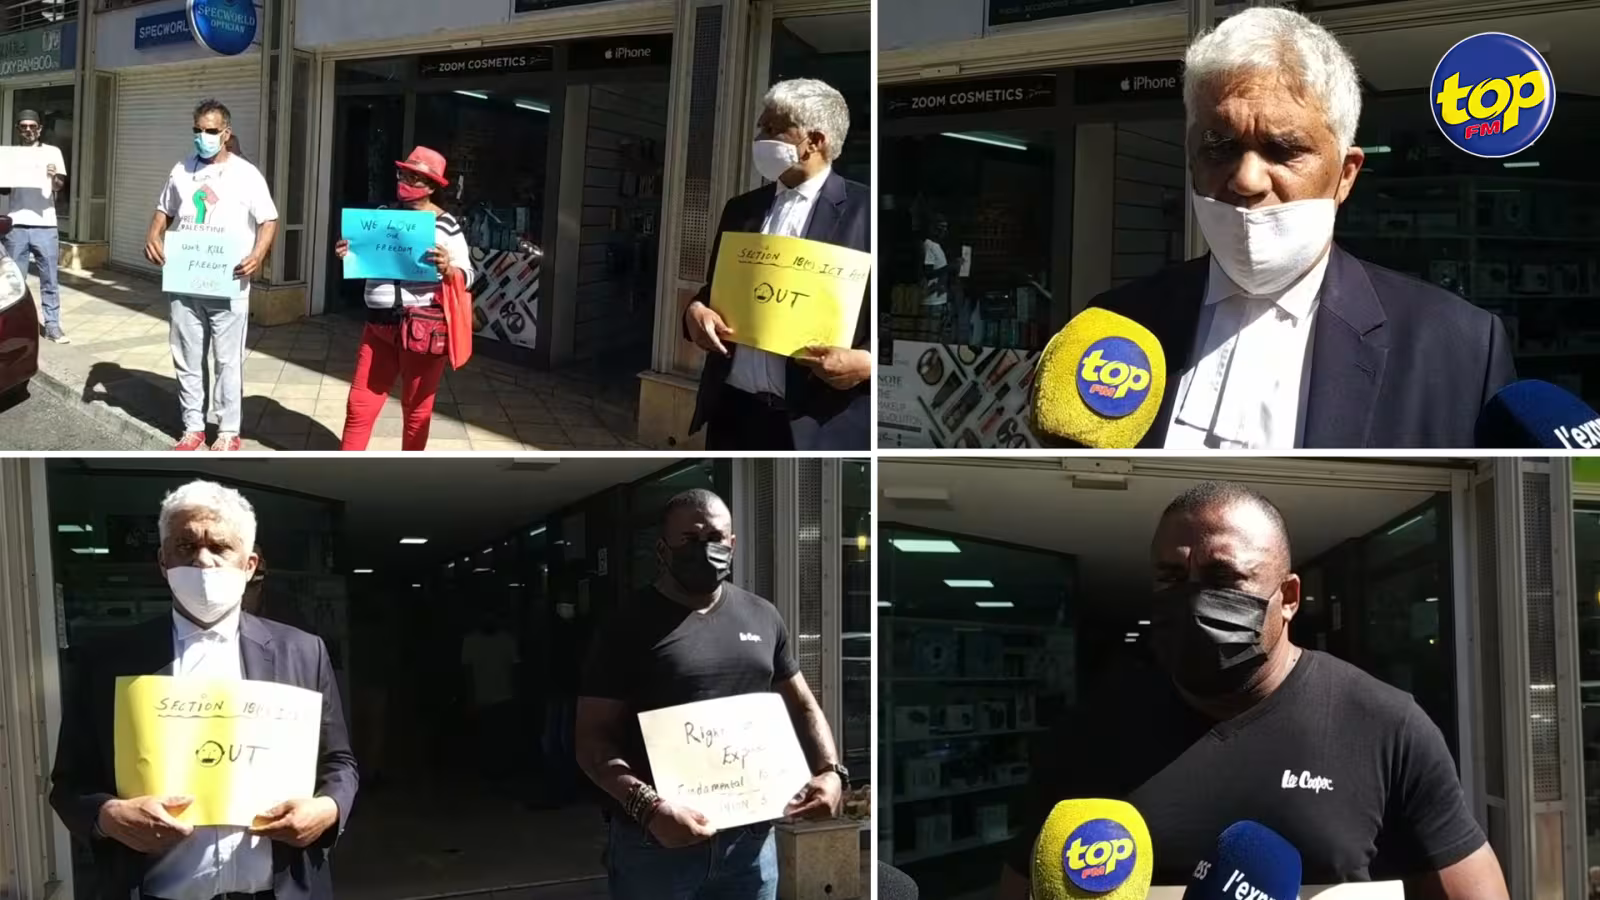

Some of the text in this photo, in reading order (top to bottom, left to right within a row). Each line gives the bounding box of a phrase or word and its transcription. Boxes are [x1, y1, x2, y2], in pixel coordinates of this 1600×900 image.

[197, 4, 256, 26] SPECWORLD
[139, 19, 193, 39] SPECWORL
[210, 19, 246, 33] OPTICIAN
[615, 47, 651, 59] iPhone
[17, 54, 52, 73] BAMBOO
[439, 56, 527, 72] ZOOM COSMETICS
[1133, 76, 1176, 90] iPhone
[911, 88, 1024, 109] ZOOM COSMETICS
[180, 223, 226, 233] PALESTINE
[360, 218, 417, 232] WE LOVE
[375, 243, 414, 256] FREEDOM
[819, 263, 844, 277] ICT
[753, 282, 811, 309] OUT
[1080, 349, 1152, 400] top
[1089, 384, 1116, 398] FM
[195, 739, 270, 768] OUT
[1065, 838, 1134, 875] top
[1081, 866, 1106, 879] FM
